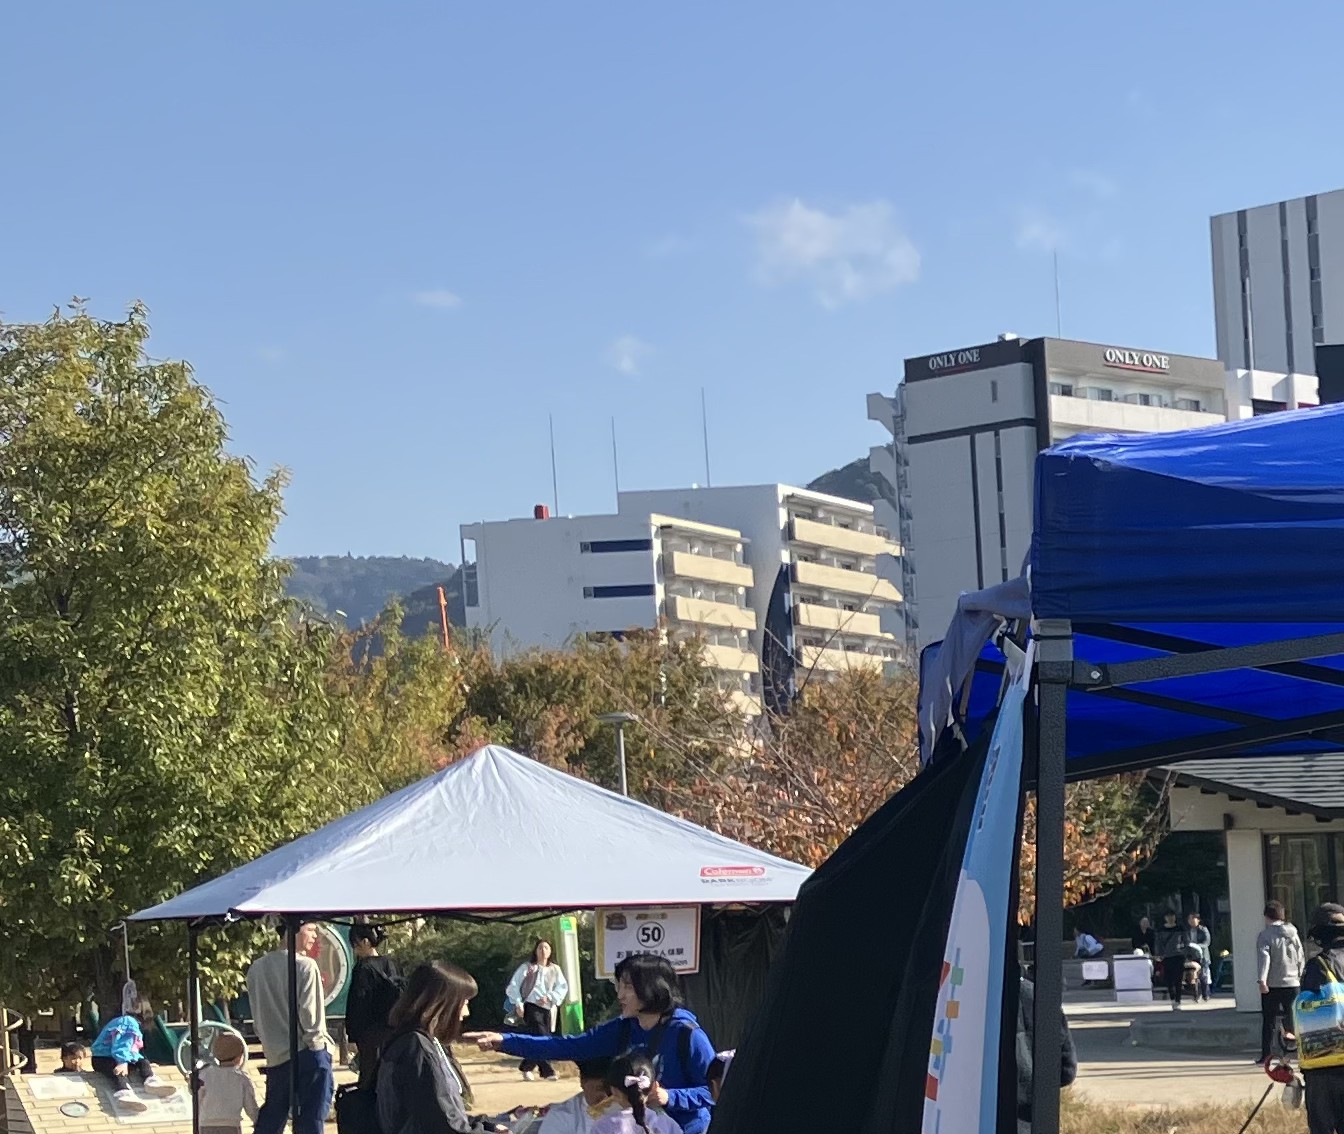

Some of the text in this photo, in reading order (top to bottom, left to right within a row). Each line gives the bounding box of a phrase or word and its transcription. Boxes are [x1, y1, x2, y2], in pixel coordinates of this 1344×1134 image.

[929, 349, 980, 370] ONLY ONE
[1105, 349, 1170, 369] ONLY ONE
[641, 927, 661, 943] 50
